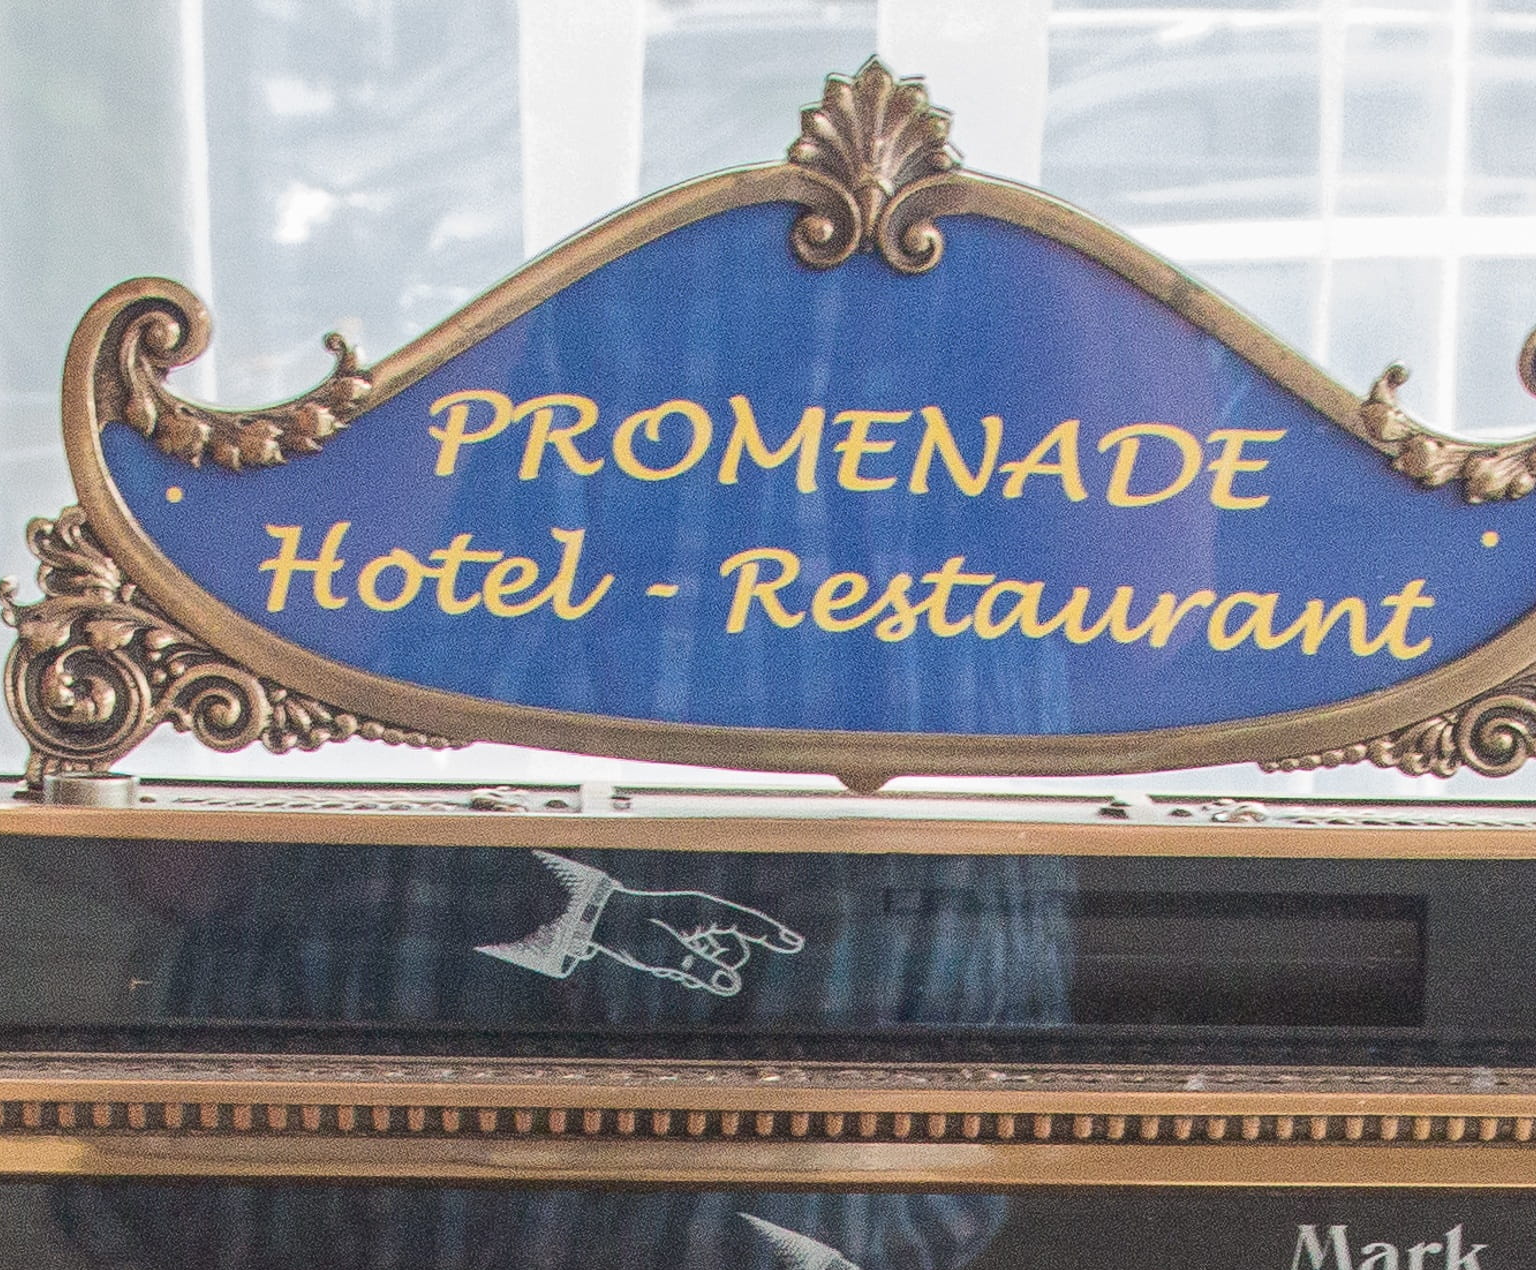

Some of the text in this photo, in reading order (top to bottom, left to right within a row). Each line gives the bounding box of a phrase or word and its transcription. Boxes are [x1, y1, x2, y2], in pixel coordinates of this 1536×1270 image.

[428, 389, 1287, 511] PROMENADE
[260, 522, 614, 620] Hotel
[720, 548, 1435, 661] Restaurant
